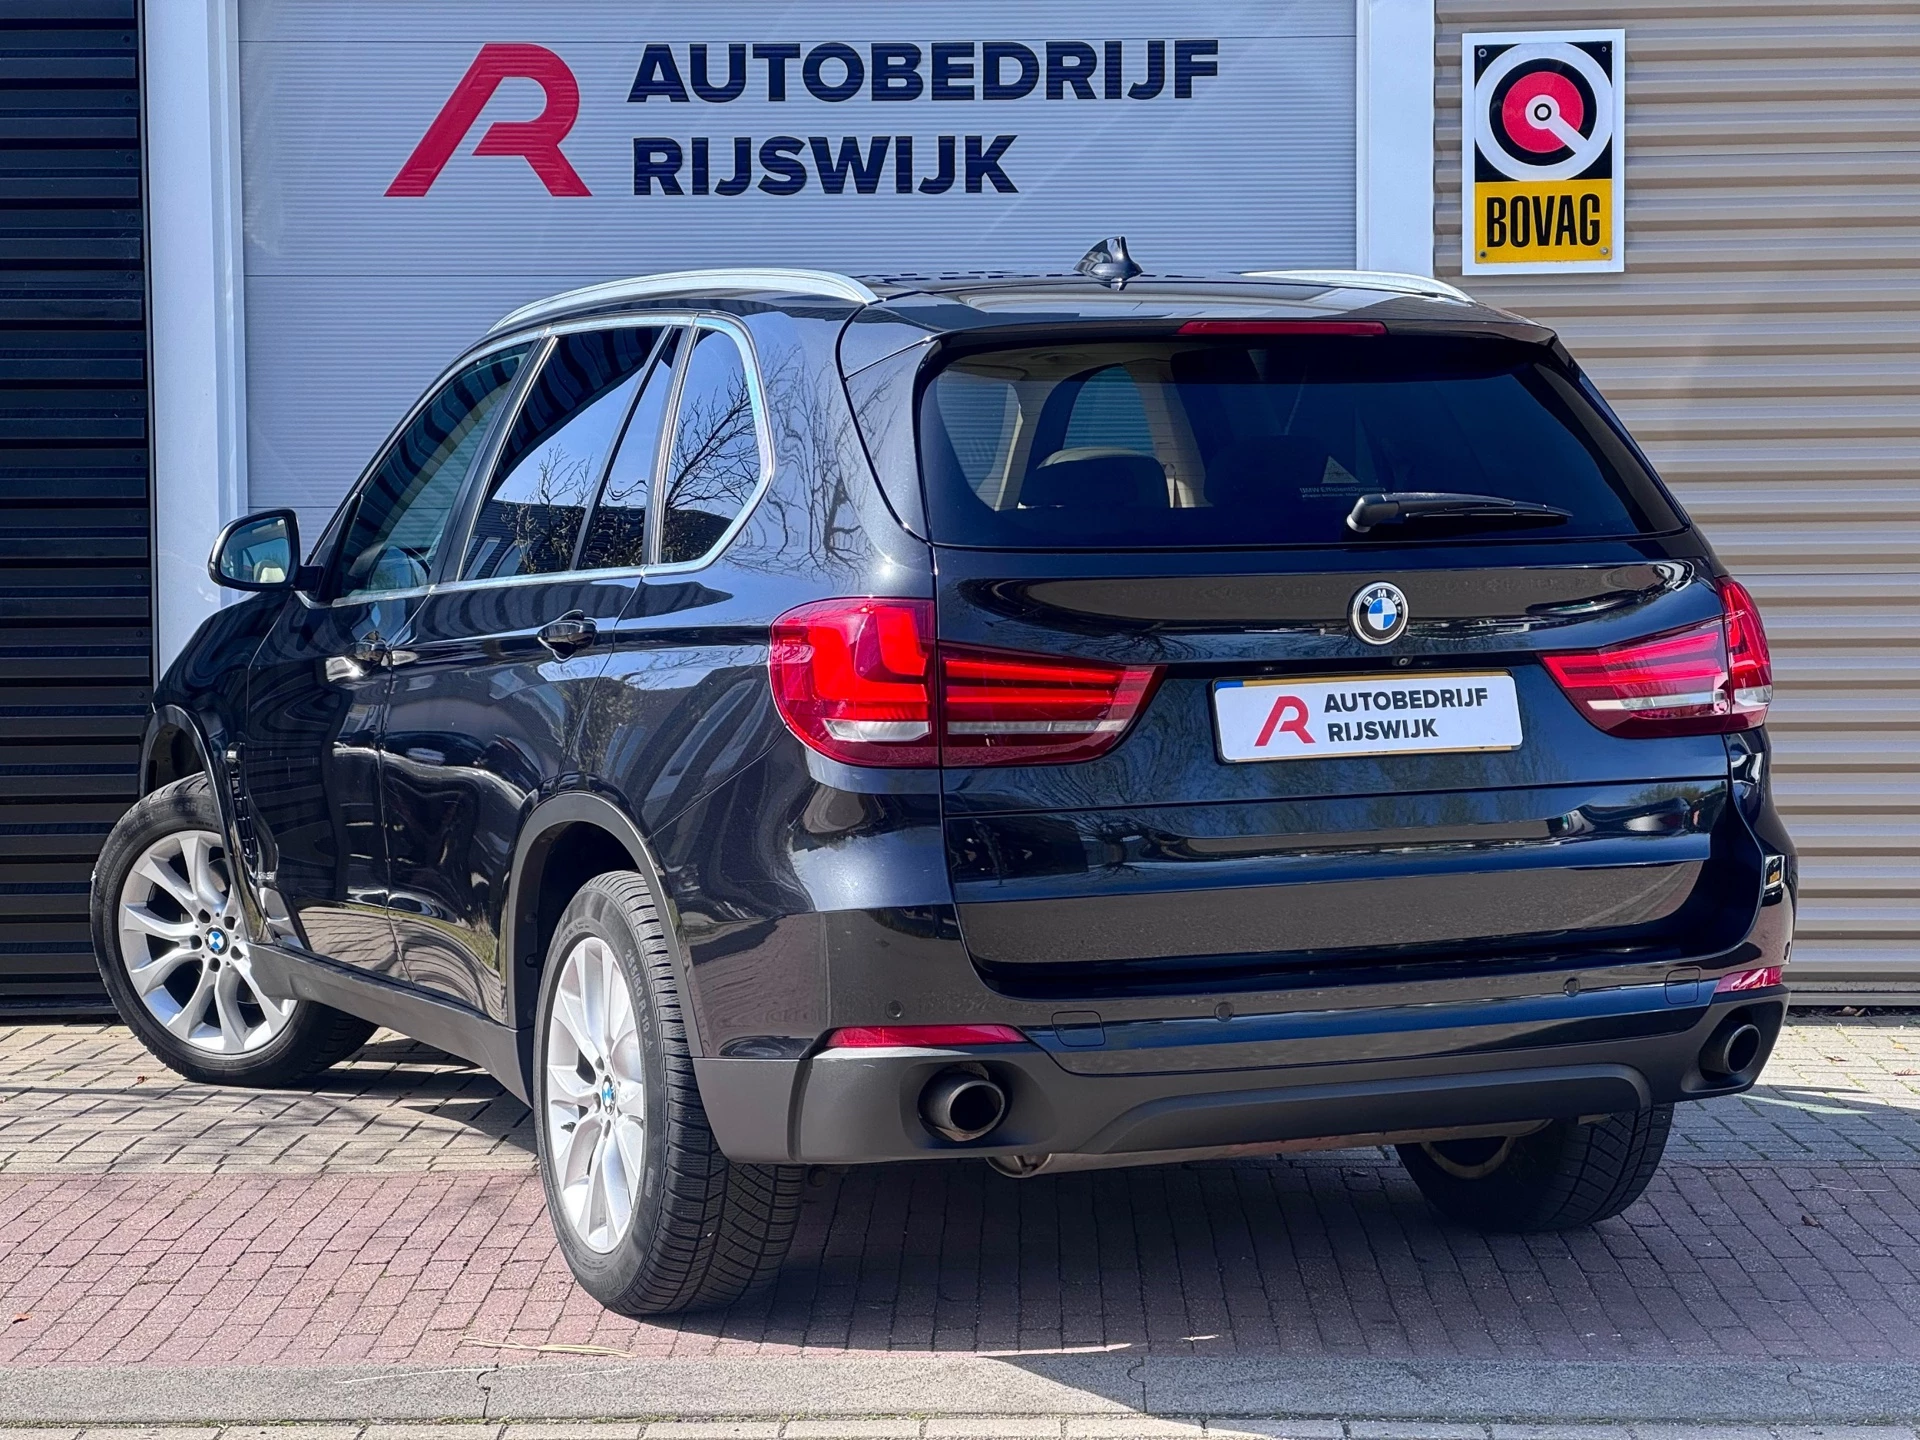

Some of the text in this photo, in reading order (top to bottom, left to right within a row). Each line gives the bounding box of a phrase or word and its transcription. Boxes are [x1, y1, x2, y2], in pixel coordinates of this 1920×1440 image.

[627, 39, 1219, 103] AUTOBEDRIJF
[633, 135, 1019, 196] RIJSWIJK
[1486, 194, 1600, 247] BOVAG
[1363, 589, 1401, 607] BMW
[1324, 688, 1488, 713] AUTOBEDRIJF
[1327, 718, 1438, 742] RIJSWIJK
[624, 948, 651, 1033] 255/50 R 19
